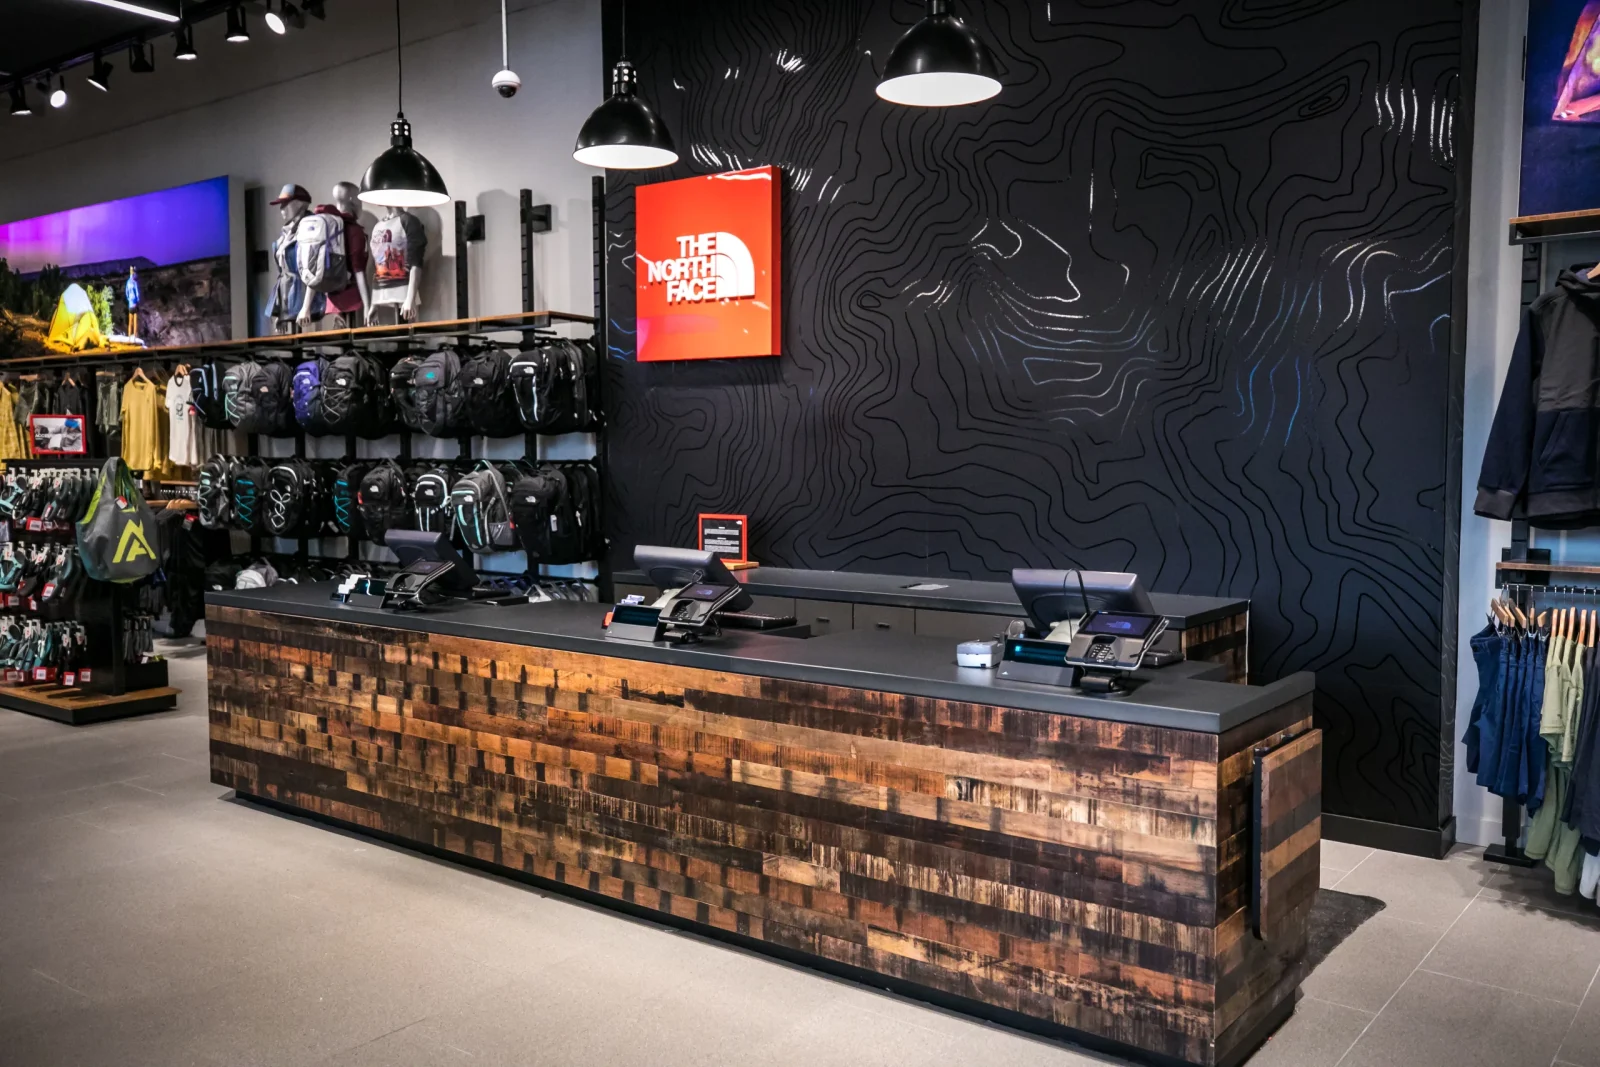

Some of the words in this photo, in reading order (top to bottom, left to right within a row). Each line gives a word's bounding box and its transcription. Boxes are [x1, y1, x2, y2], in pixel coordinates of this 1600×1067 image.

[677, 233, 716, 258] THE
[648, 255, 716, 283] NORTH
[667, 277, 716, 303] FACE
